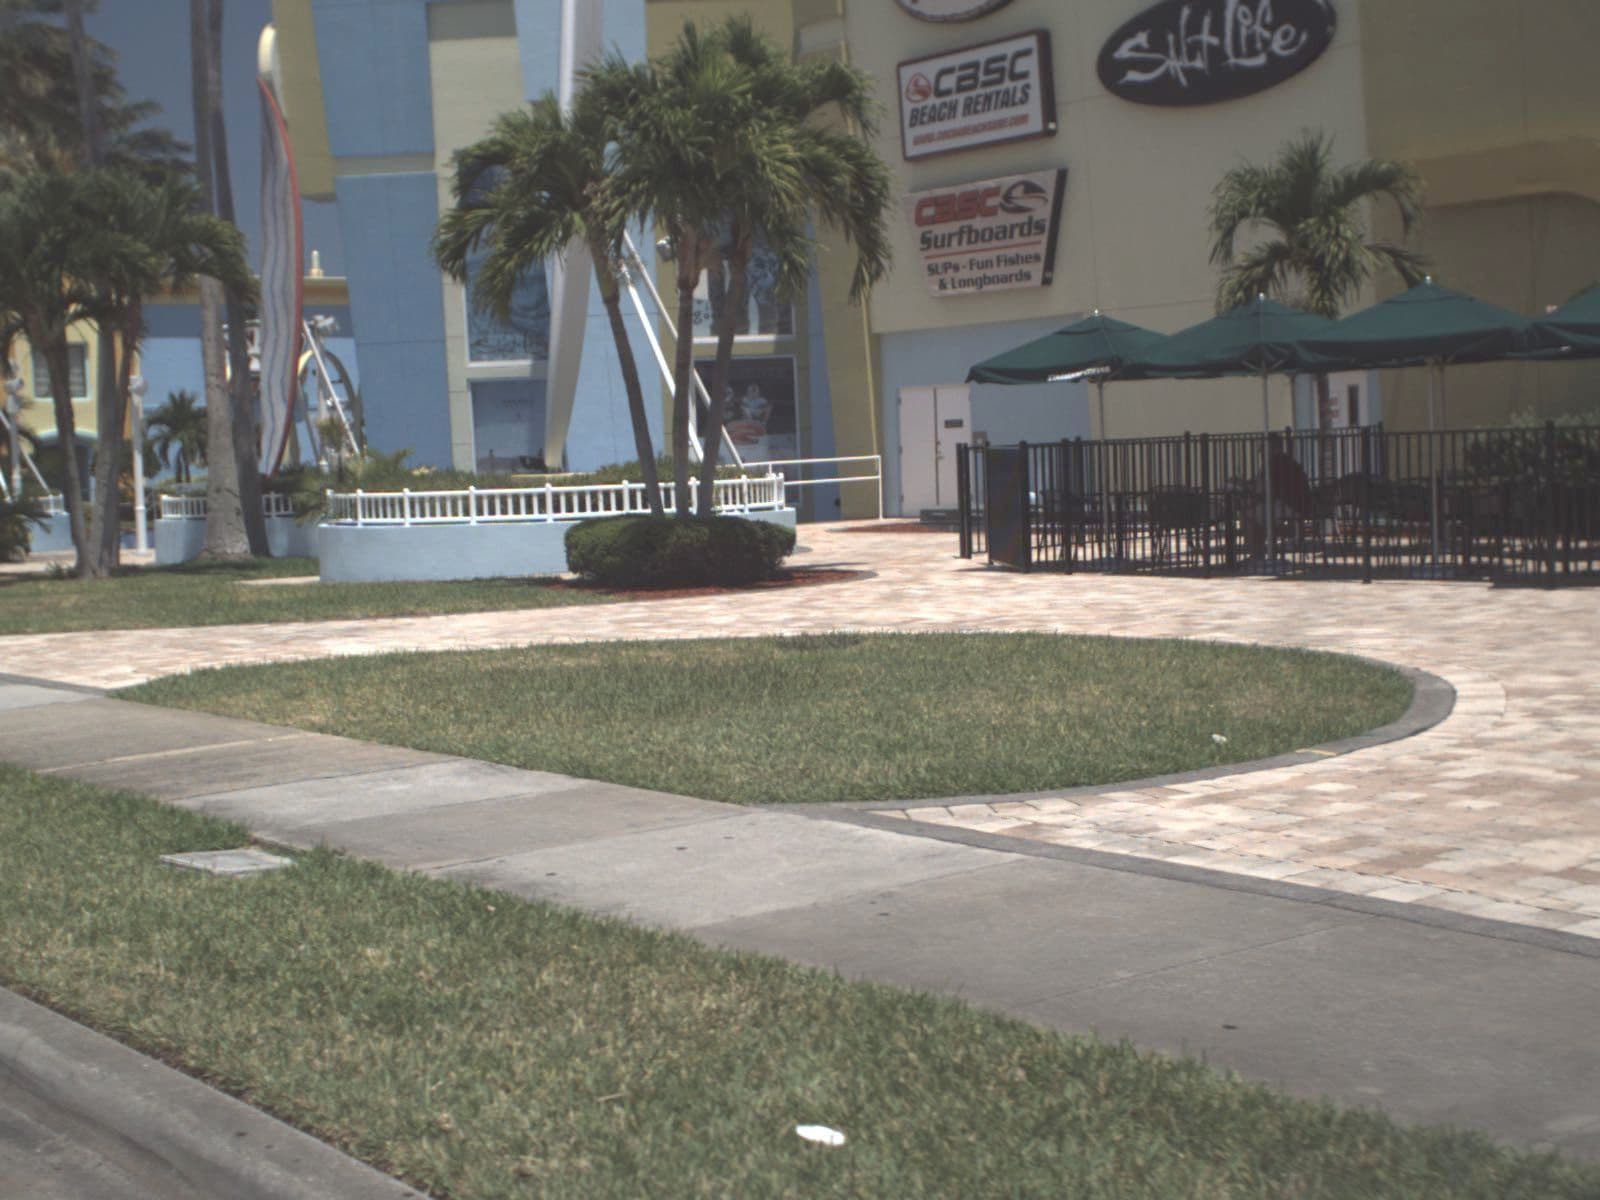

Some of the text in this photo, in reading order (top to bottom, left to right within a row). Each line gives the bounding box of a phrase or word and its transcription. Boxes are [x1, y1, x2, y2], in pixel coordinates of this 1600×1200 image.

[1223, 0, 1309, 67] Life
[909, 83, 1032, 129] BEACH RENTALS
[919, 215, 1047, 251] Surfboards
[969, 257, 994, 271] Fun
[997, 251, 1042, 268] Fishes
[938, 269, 1033, 291] & Longboards
